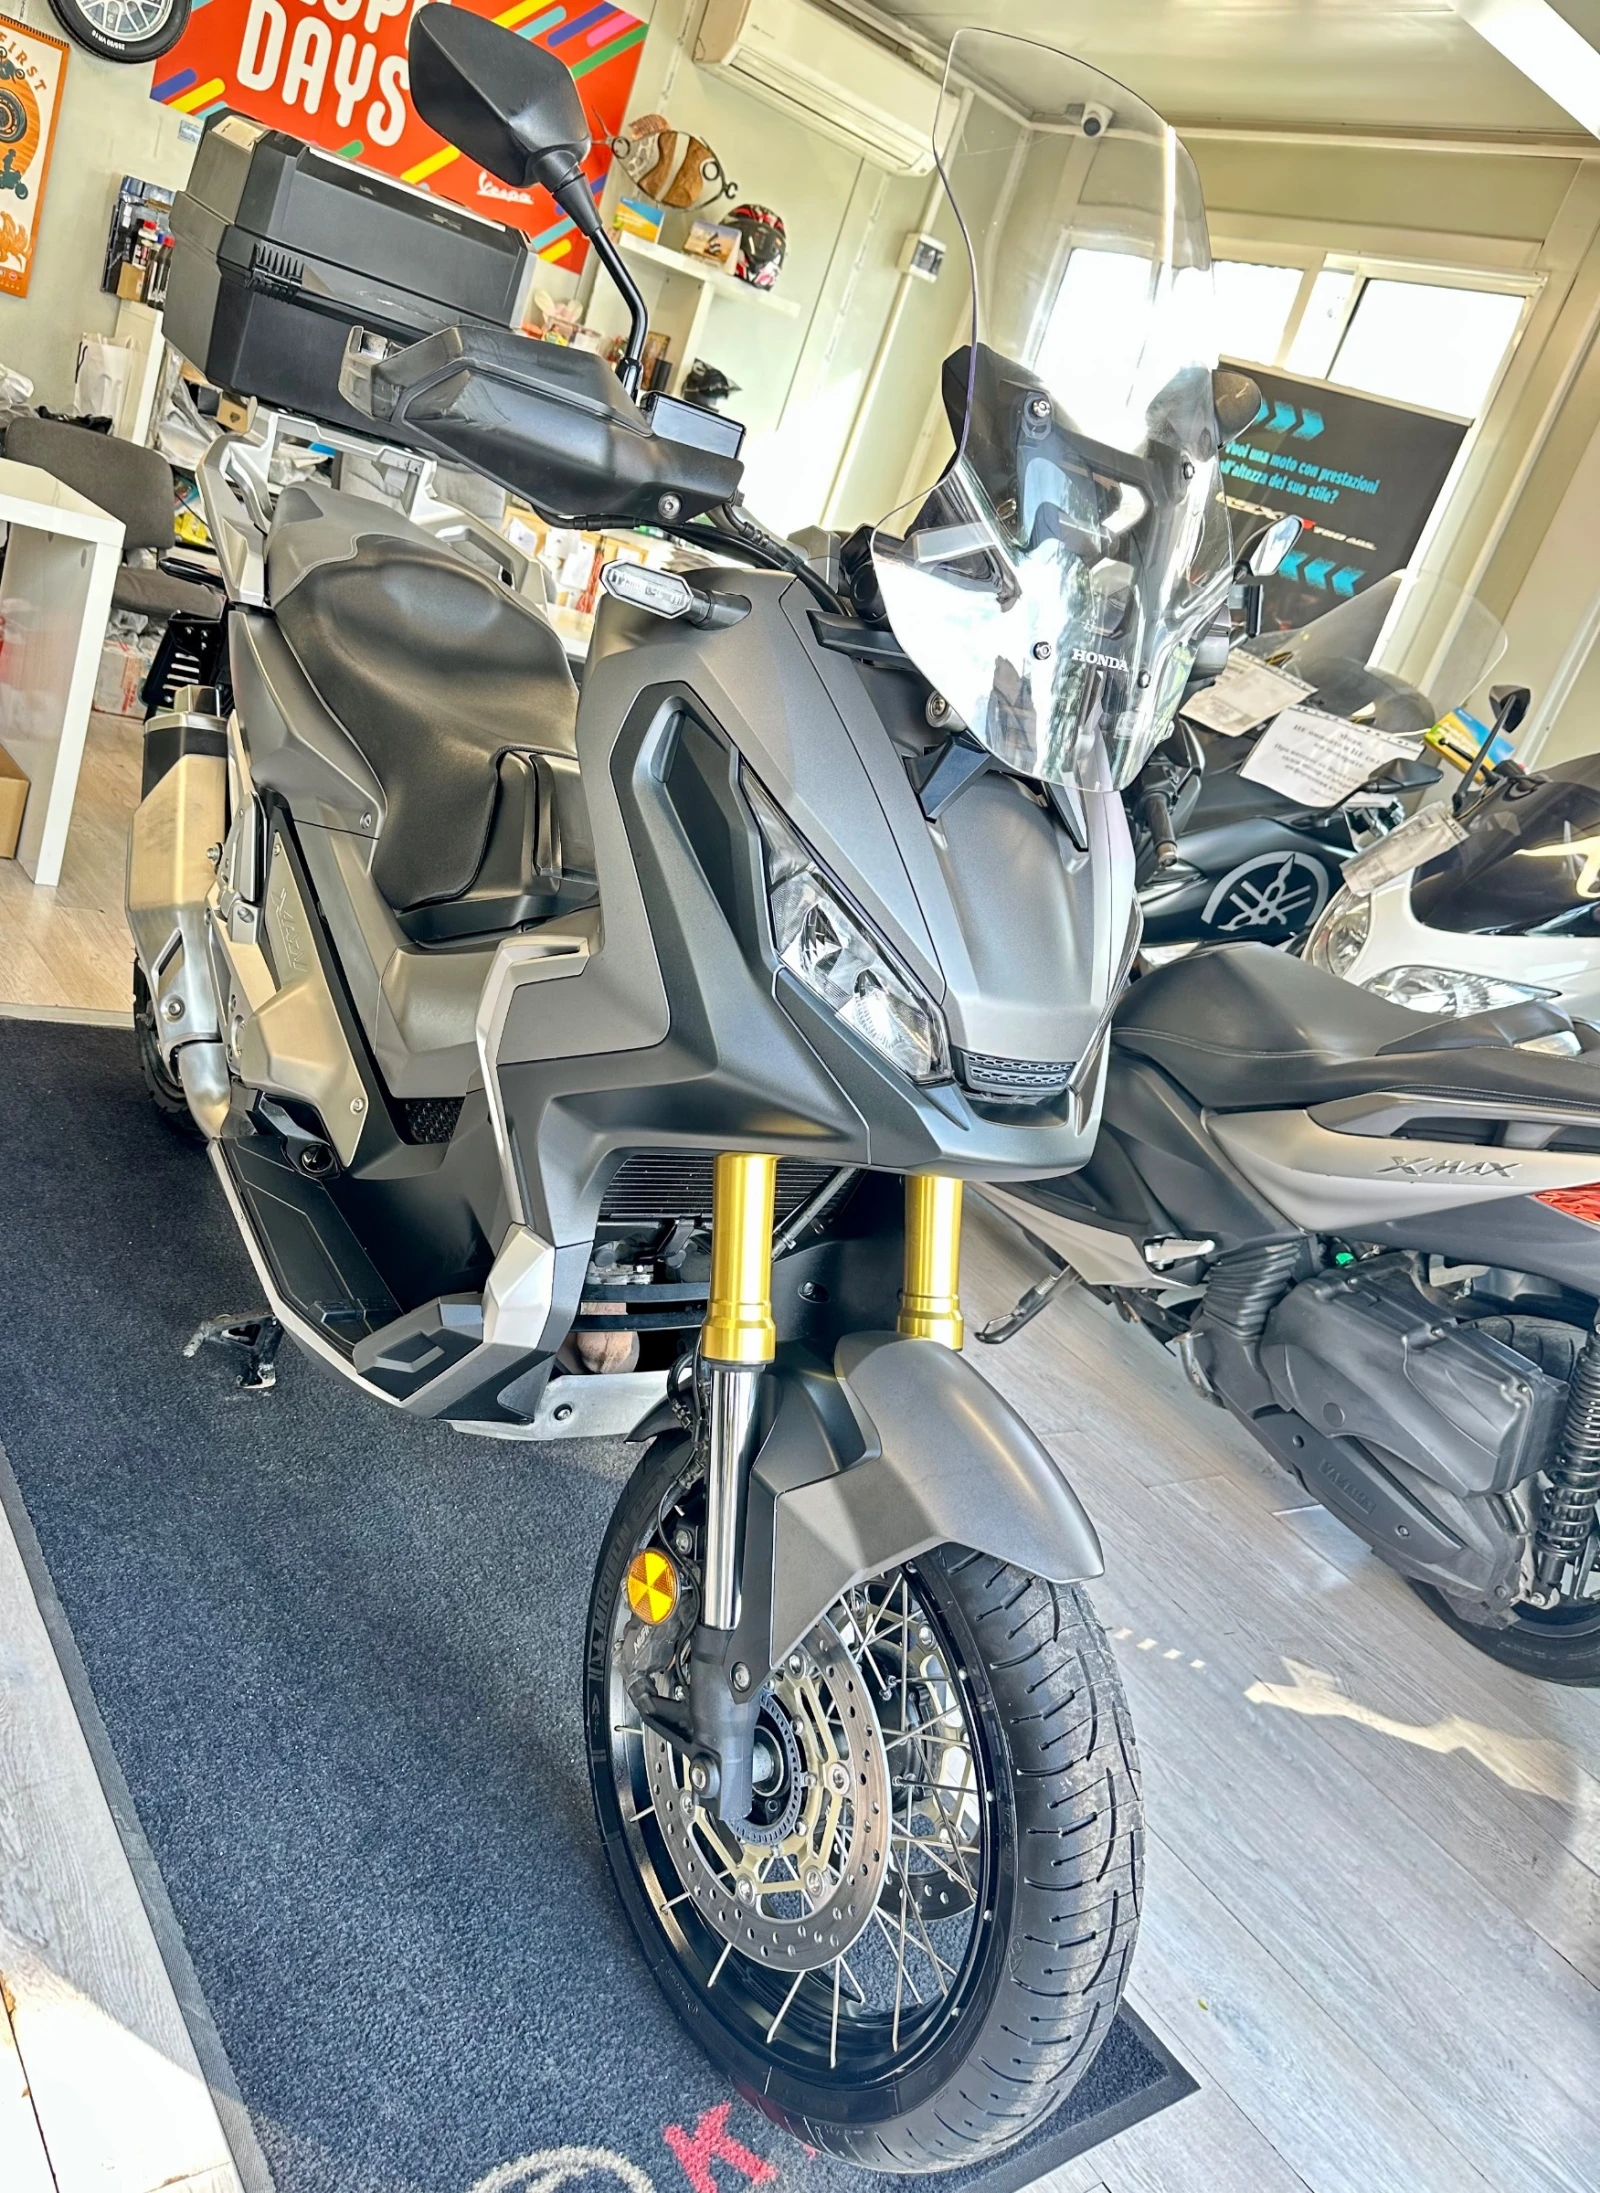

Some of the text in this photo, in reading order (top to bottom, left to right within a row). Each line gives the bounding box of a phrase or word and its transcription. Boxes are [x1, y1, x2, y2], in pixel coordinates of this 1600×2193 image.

[236, 0, 409, 146] DAYS
[476, 171, 534, 205] Vespa
[1249, 448, 1270, 464] una
[1269, 454, 1298, 472] moto
[1298, 462, 1319, 478] con
[1317, 468, 1380, 495] prestazioni
[1286, 480, 1307, 496] suo
[1306, 485, 1339, 505] stile?
[1071, 648, 1129, 673] HONDA
[593, 1522, 632, 1637] MICHELIN
